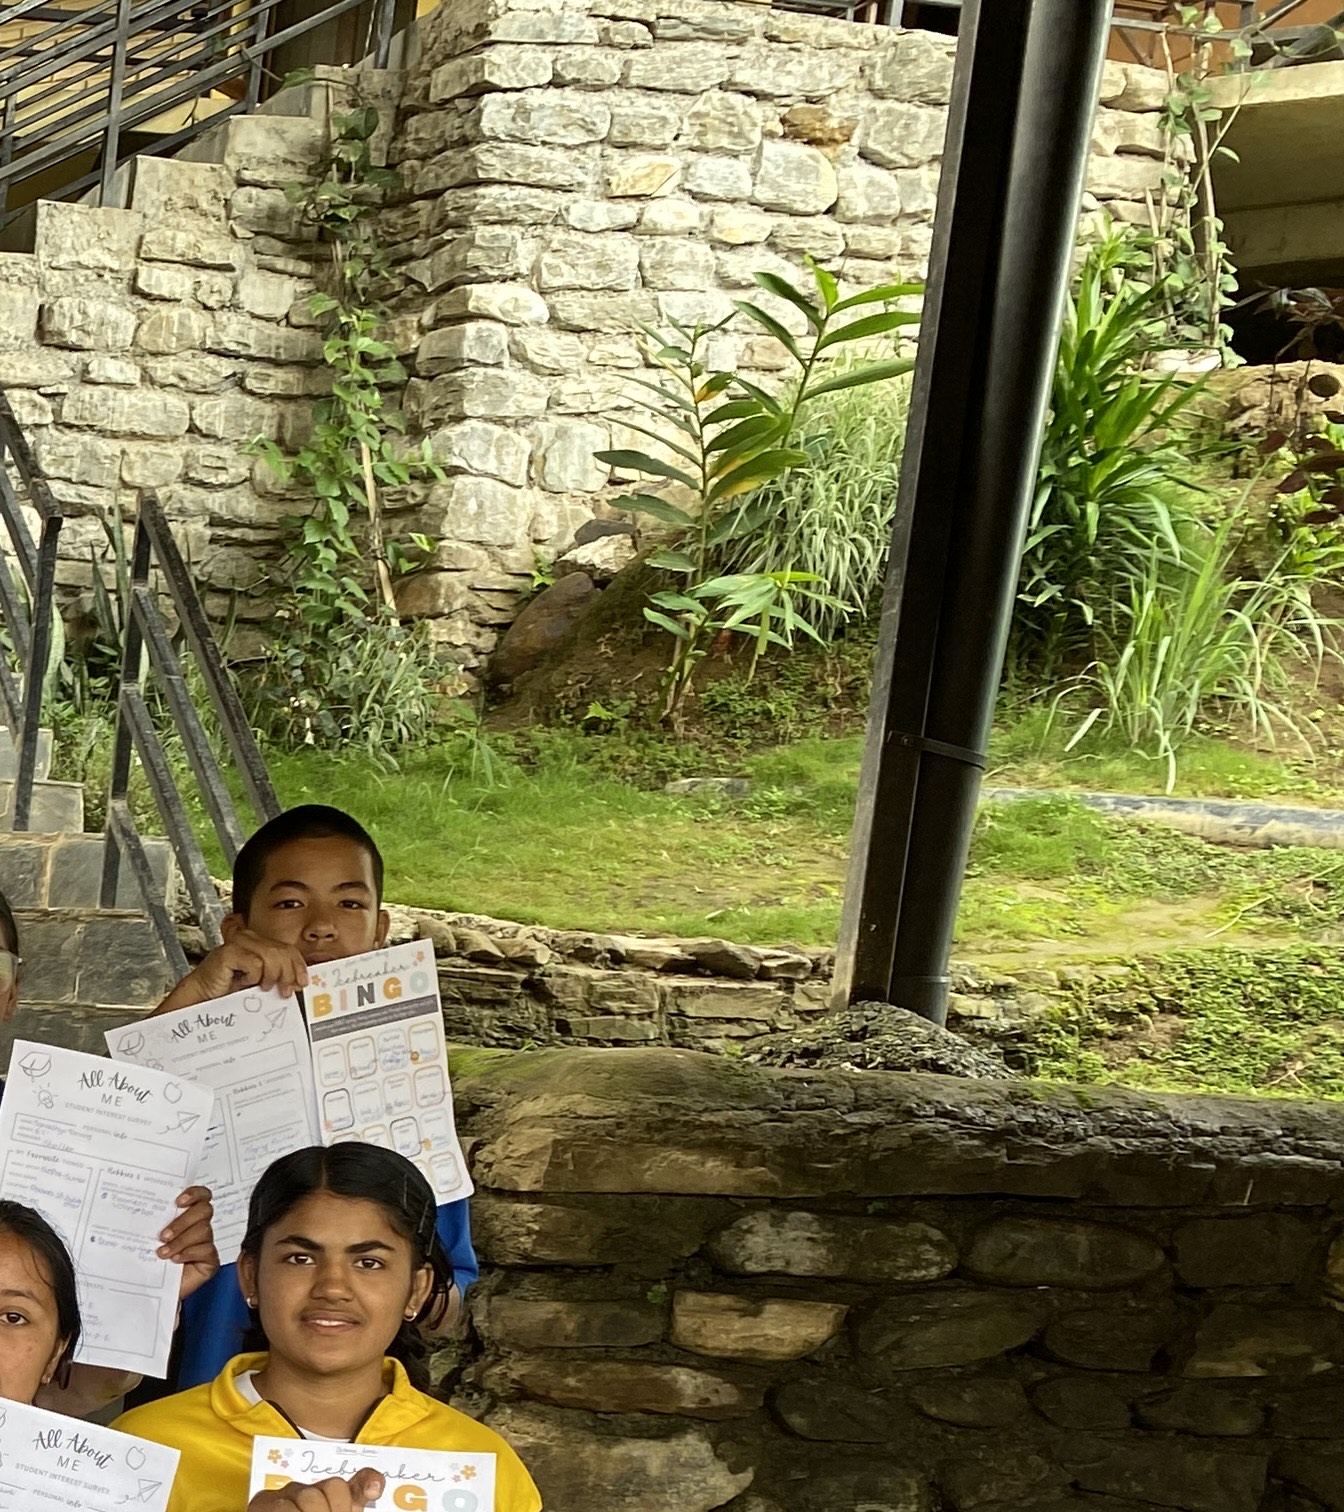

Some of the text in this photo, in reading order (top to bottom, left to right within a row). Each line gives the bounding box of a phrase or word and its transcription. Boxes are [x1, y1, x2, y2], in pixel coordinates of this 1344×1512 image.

[313, 971, 429, 1018] BINGO
[169, 1013, 237, 1043] All About
[197, 1031, 217, 1044] ME
[77, 1070, 153, 1104] All About
[101, 1093, 123, 1107] ME
[32, 1429, 115, 1471] All About
[56, 1455, 81, 1472] ME
[15, 1462, 110, 1495] STUDENT INTEREST SURVEY
[301, 1451, 445, 1482] Icebraker
